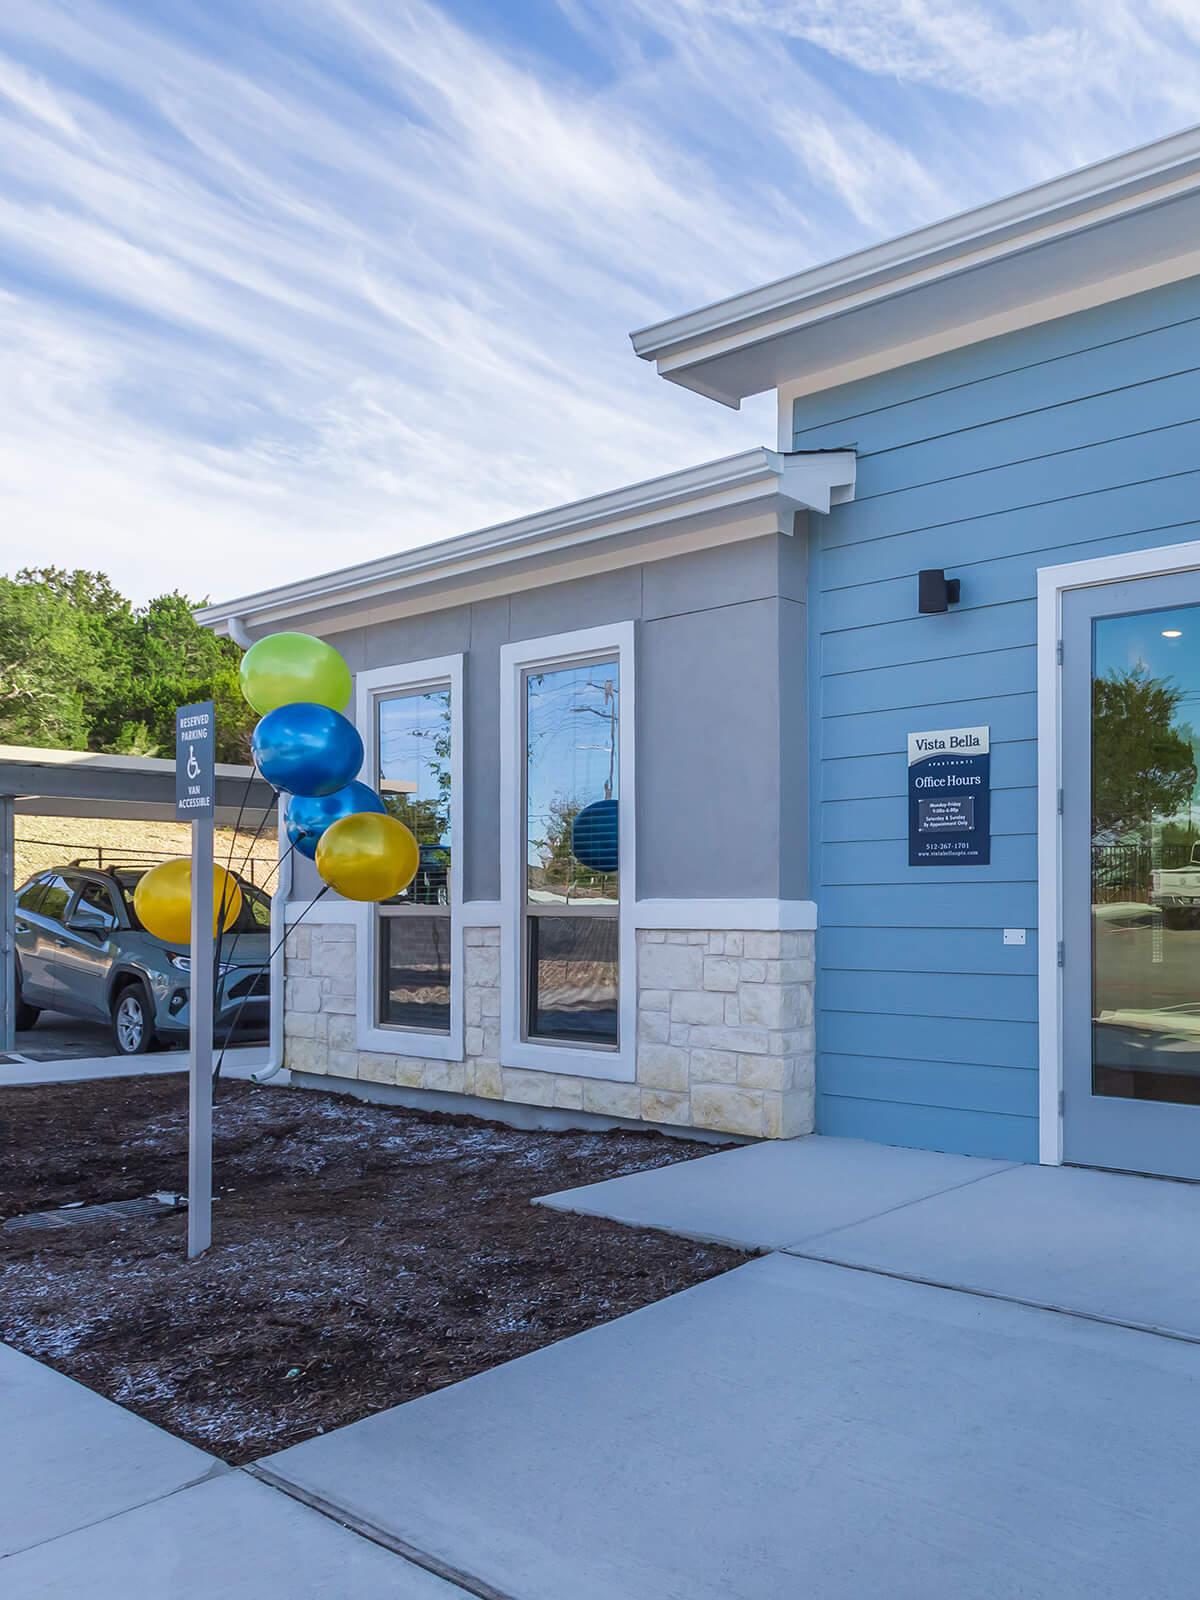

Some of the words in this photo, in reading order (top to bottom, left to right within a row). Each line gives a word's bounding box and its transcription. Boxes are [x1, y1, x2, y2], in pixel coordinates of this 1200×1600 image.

[181, 714, 209, 728] RESERVED
[181, 728, 208, 741] PARKING
[916, 738, 946, 751] Vista
[950, 734, 980, 748] Bella
[915, 776, 946, 788] Office
[947, 775, 981, 786] Hours
[188, 785, 200, 795] VAN
[179, 797, 210, 808] ACCESSIBLE
